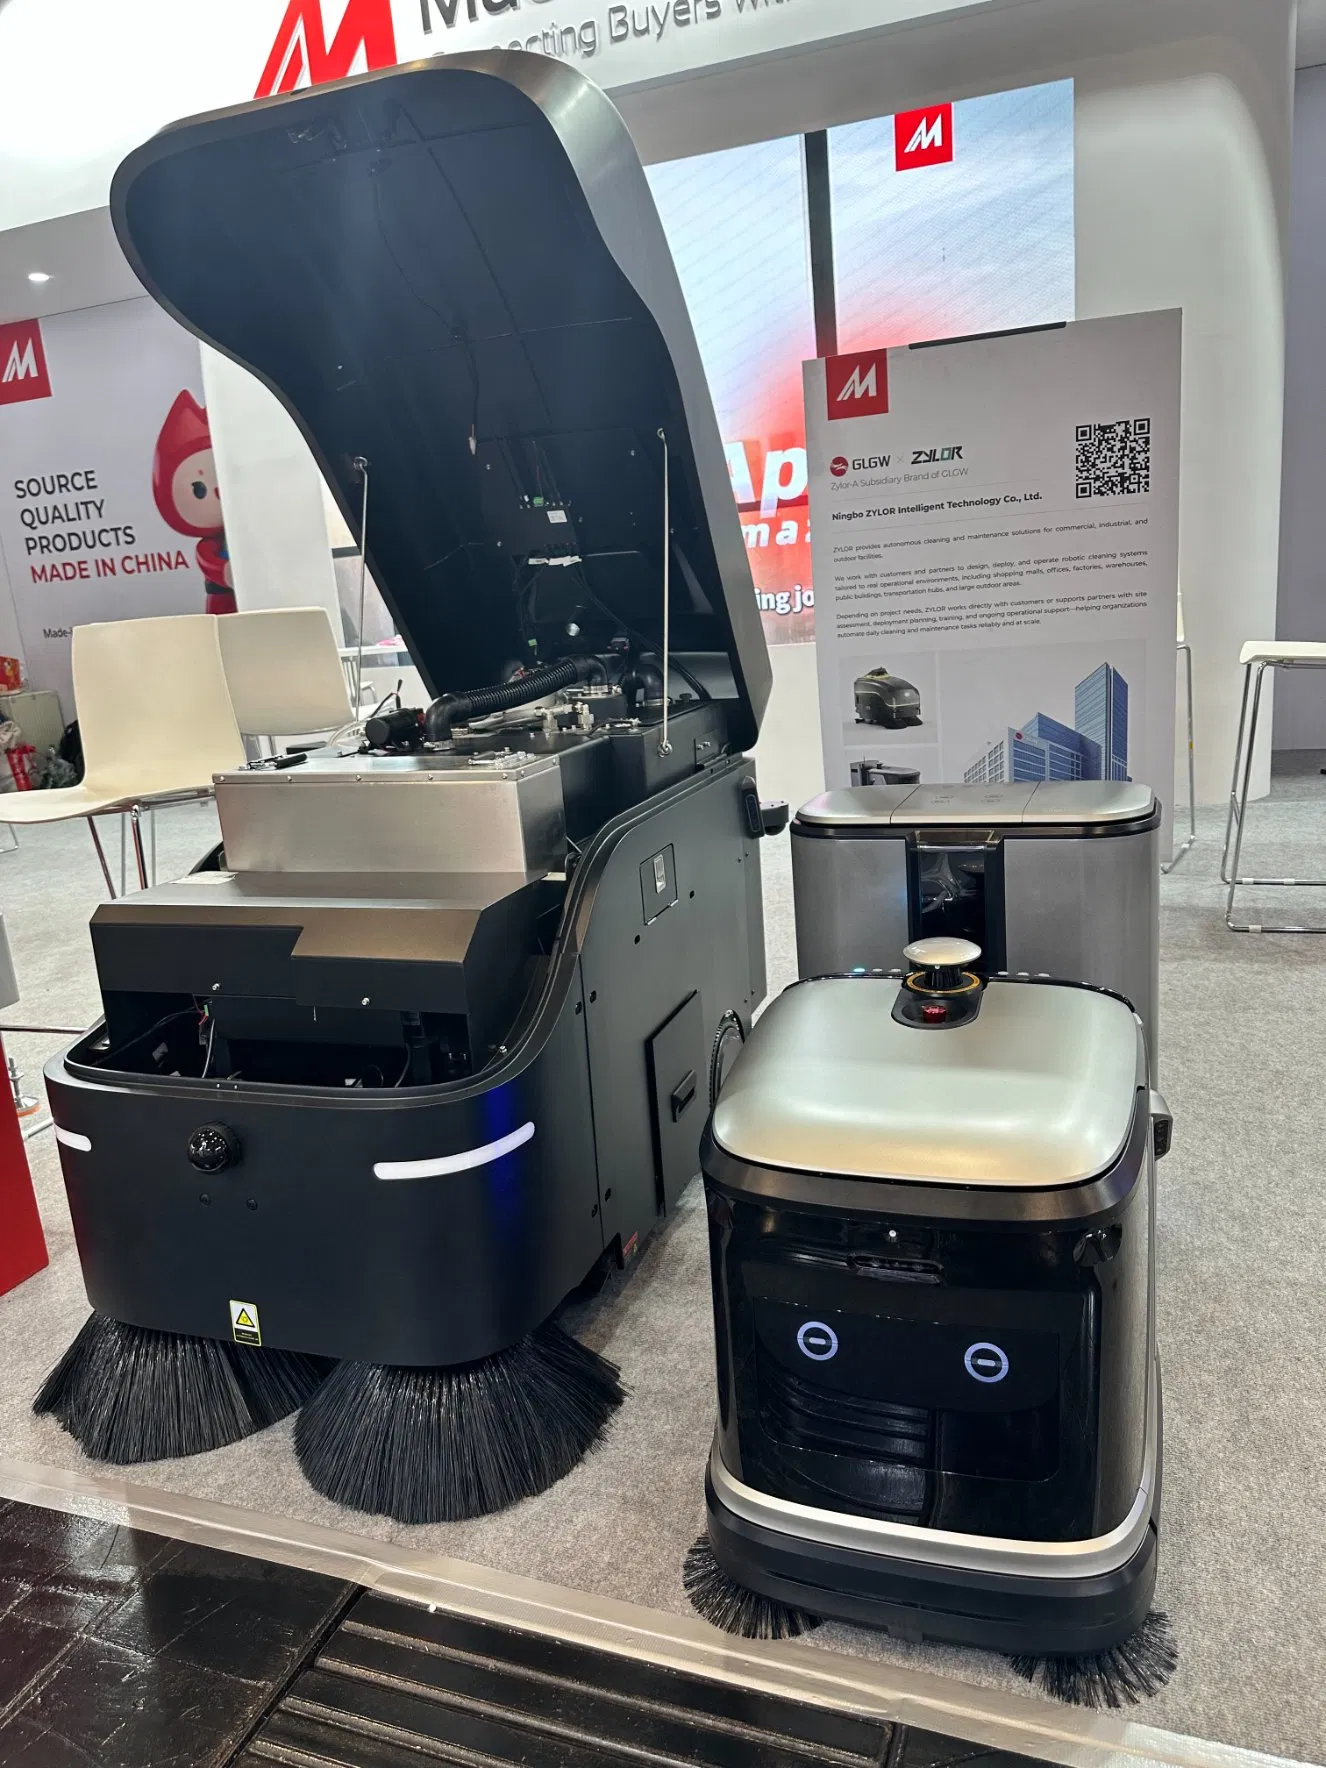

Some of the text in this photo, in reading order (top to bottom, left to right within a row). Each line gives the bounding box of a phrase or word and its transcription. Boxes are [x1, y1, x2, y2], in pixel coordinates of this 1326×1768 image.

[608, 0, 721, 44] Buyers
[852, 455, 891, 471] GLGW
[911, 446, 963, 465] ZYLOR
[14, 470, 98, 499] SOURCE
[829, 467, 968, 491] Zylor-A Subsidiary Brand of GLGW
[20, 499, 104, 530] QUALITY
[831, 491, 1042, 520] Ningbo ZYLOR Intelligent Technology Co., Ltd.
[25, 525, 136, 555] PRODUCTS
[832, 545, 854, 553] ZYLOR
[855, 543, 881, 551] provides
[882, 539, 922, 548] autonomous
[922, 536, 950, 544] cleaning
[967, 531, 1009, 539] maintenance
[1010, 528, 1041, 536] solutions
[1054, 522, 1096, 532] commercial,
[1098, 519, 1132, 527] industrial,
[30, 550, 189, 584] MADE IN CHINA
[879, 578, 914, 588] operational
[914, 576, 960, 584] environments,
[992, 570, 1024, 578] shopping
[1104, 560, 1148, 568] warehouses,
[928, 566, 955, 574] partners
[991, 560, 1016, 568] deploy,
[1031, 557, 1059, 565] operate
[1119, 550, 1148, 558] systems
[835, 611, 869, 619] Depending
[1055, 595, 1085, 603] supports
[1086, 593, 1116, 601] partners
[883, 588, 926, 597] transportation
[872, 618, 909, 626] deployment
[908, 616, 938, 624] planning,
[978, 611, 1005, 619] ongoing
[1005, 608, 1042, 617] operational
[1043, 604, 1101, 614] support—helping
[1101, 601, 1147, 610] organizations
[919, 624, 959, 632] maintenance
